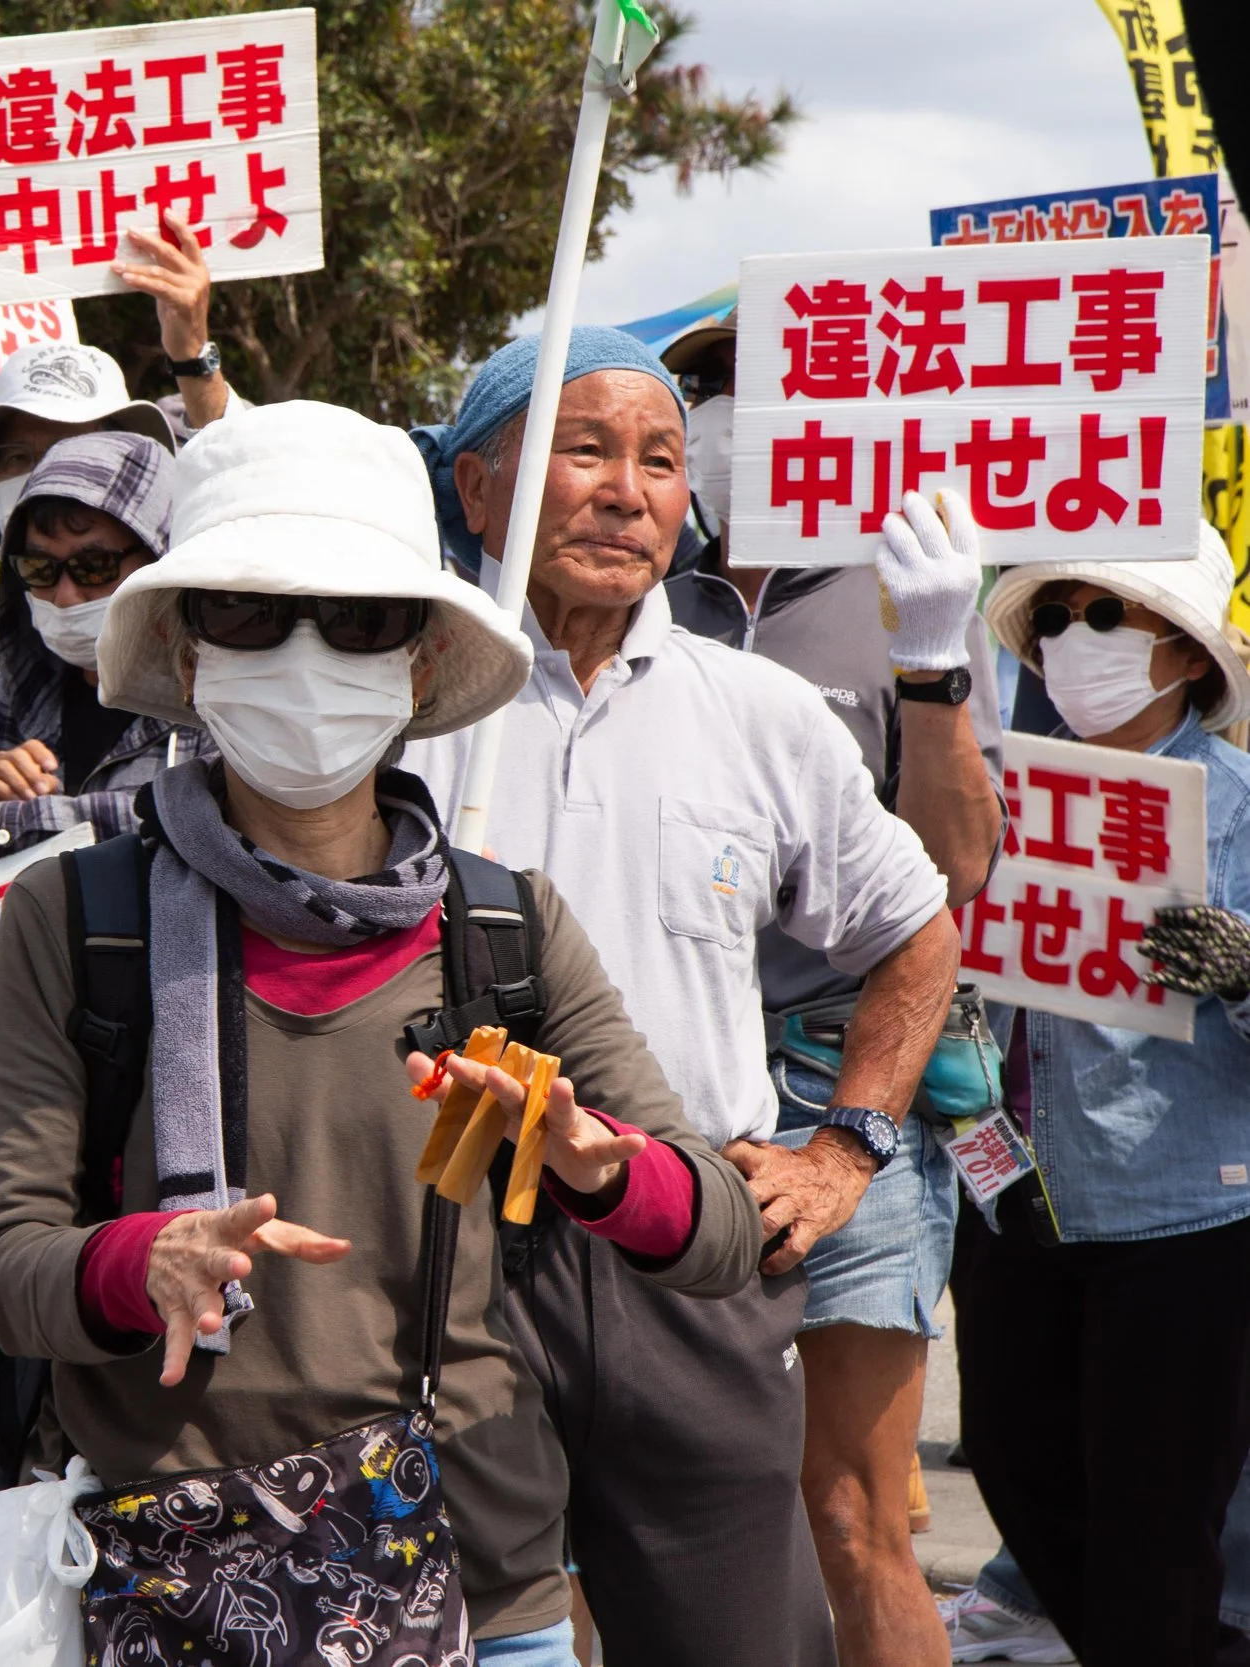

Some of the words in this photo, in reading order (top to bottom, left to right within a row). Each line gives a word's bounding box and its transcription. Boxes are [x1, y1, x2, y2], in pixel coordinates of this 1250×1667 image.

[781, 268, 1165, 400] 違法工事
[771, 413, 1166, 538] 中止せよ!
[975, 1126, 1017, 1177] 共謀罪
